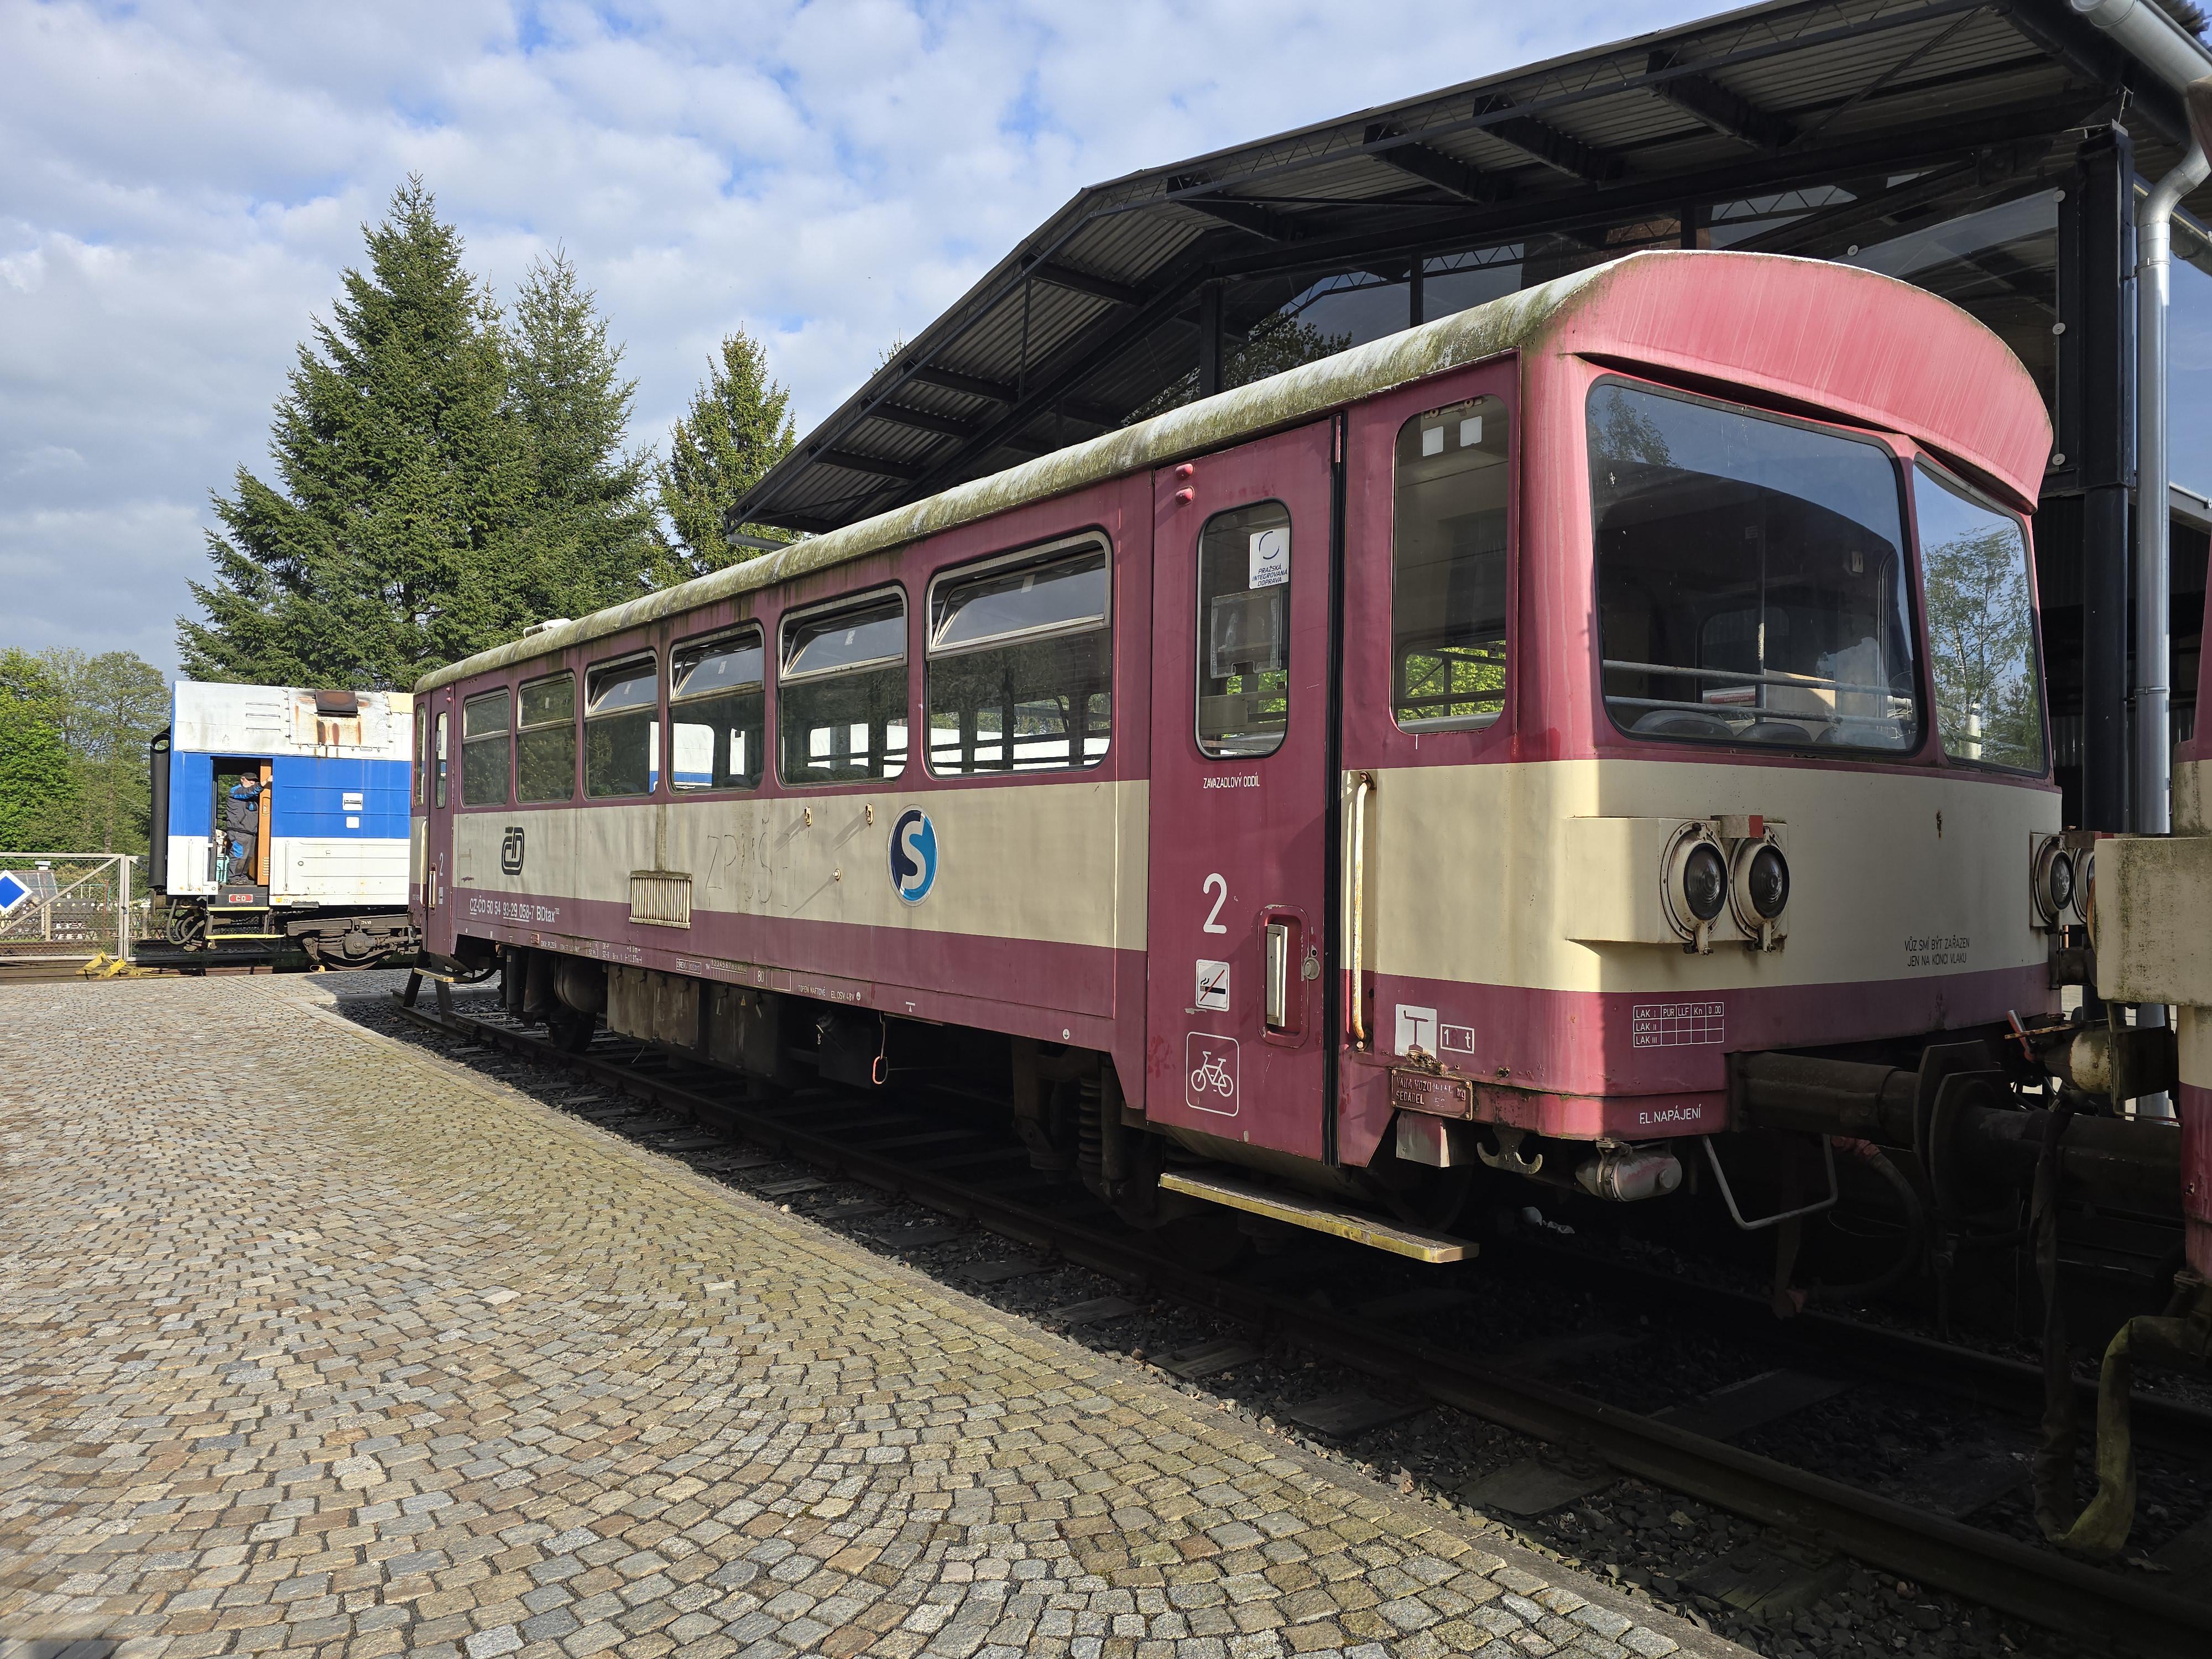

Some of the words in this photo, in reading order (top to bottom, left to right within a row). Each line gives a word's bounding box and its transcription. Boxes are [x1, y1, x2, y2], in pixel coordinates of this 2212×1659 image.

[1258, 576, 1282, 586] DOPRAVA
[1203, 771, 1242, 789] ZAVAZADLOVÝ
[1244, 771, 1260, 787] ODDÍL
[439, 852, 444, 876] 2
[469, 895, 486, 913] CZ-ČD
[487, 900, 493, 914] 50
[494, 901, 501, 915] 54
[503, 902, 518, 917] 93-29
[519, 903, 535, 920] 058-7
[1203, 873, 1227, 933] 2
[1905, 936, 1917, 951] VŮZ
[1919, 936, 1929, 951] SMÍ
[1931, 935, 1943, 950] BÝT
[1944, 935, 1970, 950] ZAŘAZEN
[1907, 955, 1919, 967] JEN
[1922, 955, 1930, 966] NA
[1932, 953, 1948, 965] KONCI
[1950, 952, 1967, 964] VLAKU
[757, 971, 764, 983] 80
[1636, 1009, 1651, 1018] LAK
[1663, 1008, 1674, 1017] PUR
[1678, 1007, 1689, 1016] LLF
[1694, 1007, 1703, 1015] Kn
[1636, 1022, 1650, 1031] LAK
[1465, 1032, 1471, 1048] t
[1636, 1036, 1650, 1045] LAK
[1396, 1090, 1425, 1105] SEDADEL
